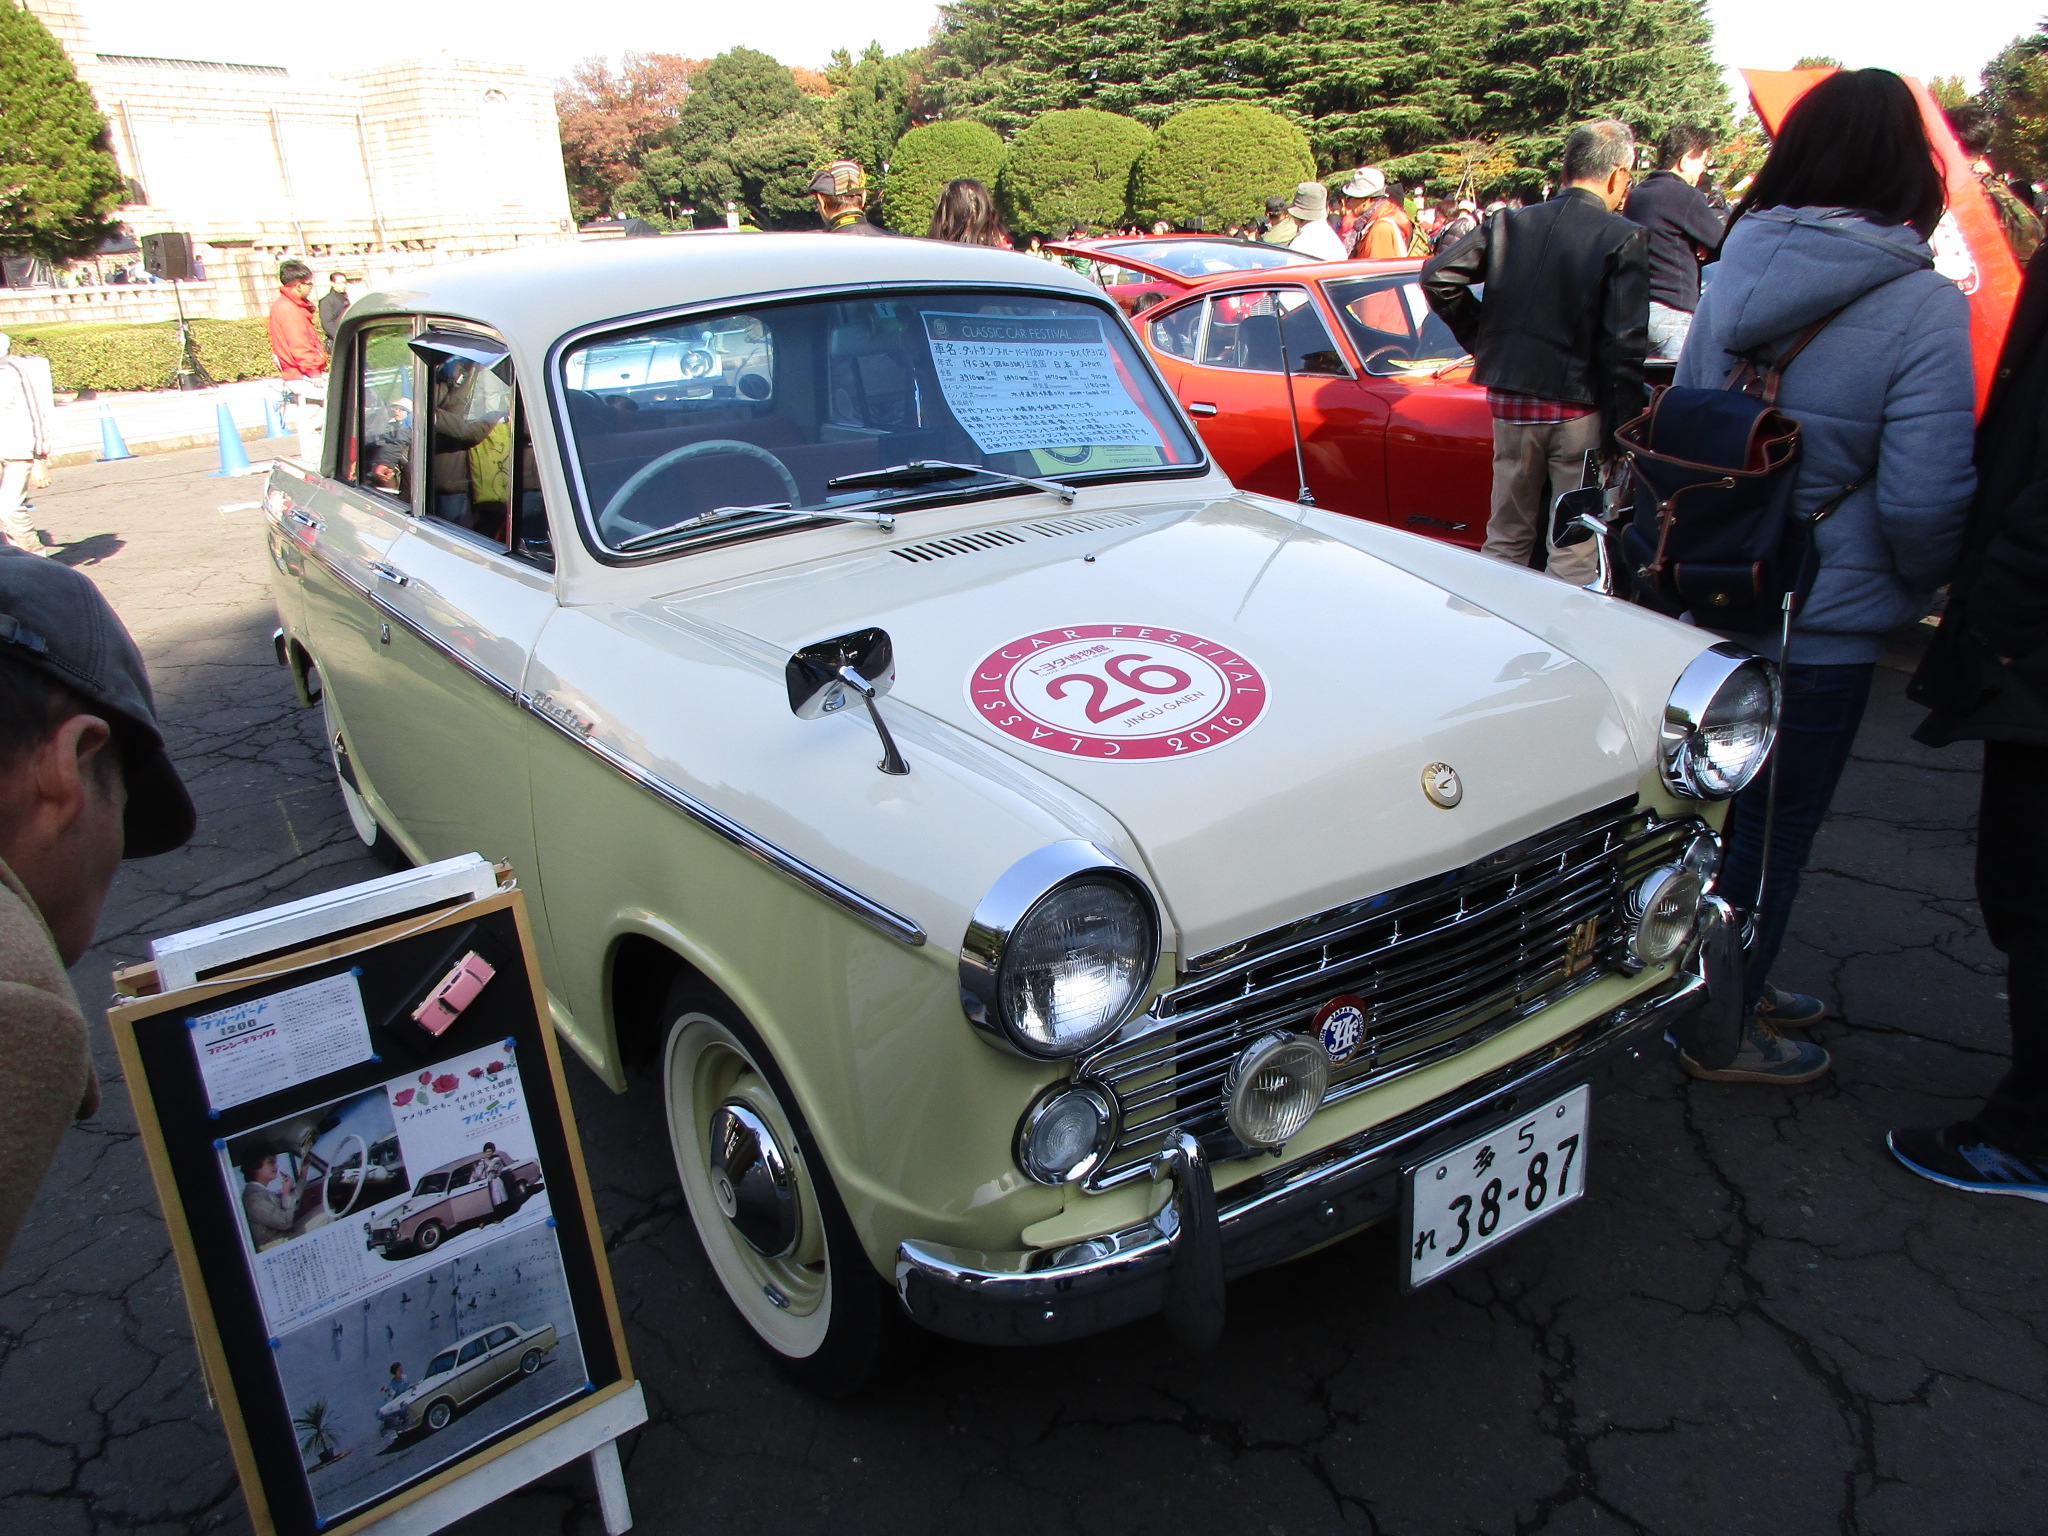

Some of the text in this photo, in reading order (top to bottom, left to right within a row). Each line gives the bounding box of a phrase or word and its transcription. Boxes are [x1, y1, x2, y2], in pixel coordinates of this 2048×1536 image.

[961, 325, 1004, 339] CLASSIC
[1005, 327, 1026, 339] CAR
[1029, 328, 1071, 340] FESTIVAL
[1029, 644, 1110, 675] トヨタ博物館
[978, 626, 1259, 756] CLASSIC CAR FESTIVAL
[1046, 653, 1192, 724] 26
[1123, 690, 1207, 728] JINGU GAIEN
[1167, 715, 1244, 752] 2016
[200, 1002, 270, 1030] ブルーバード
[220, 1019, 258, 1036] 1200
[1330, 1007, 1353, 1020] JAPAN
[1473, 1120, 1536, 1178] 多 5
[720, 1178, 732, 1204] D
[1413, 1133, 1580, 1261] れ 38-87
